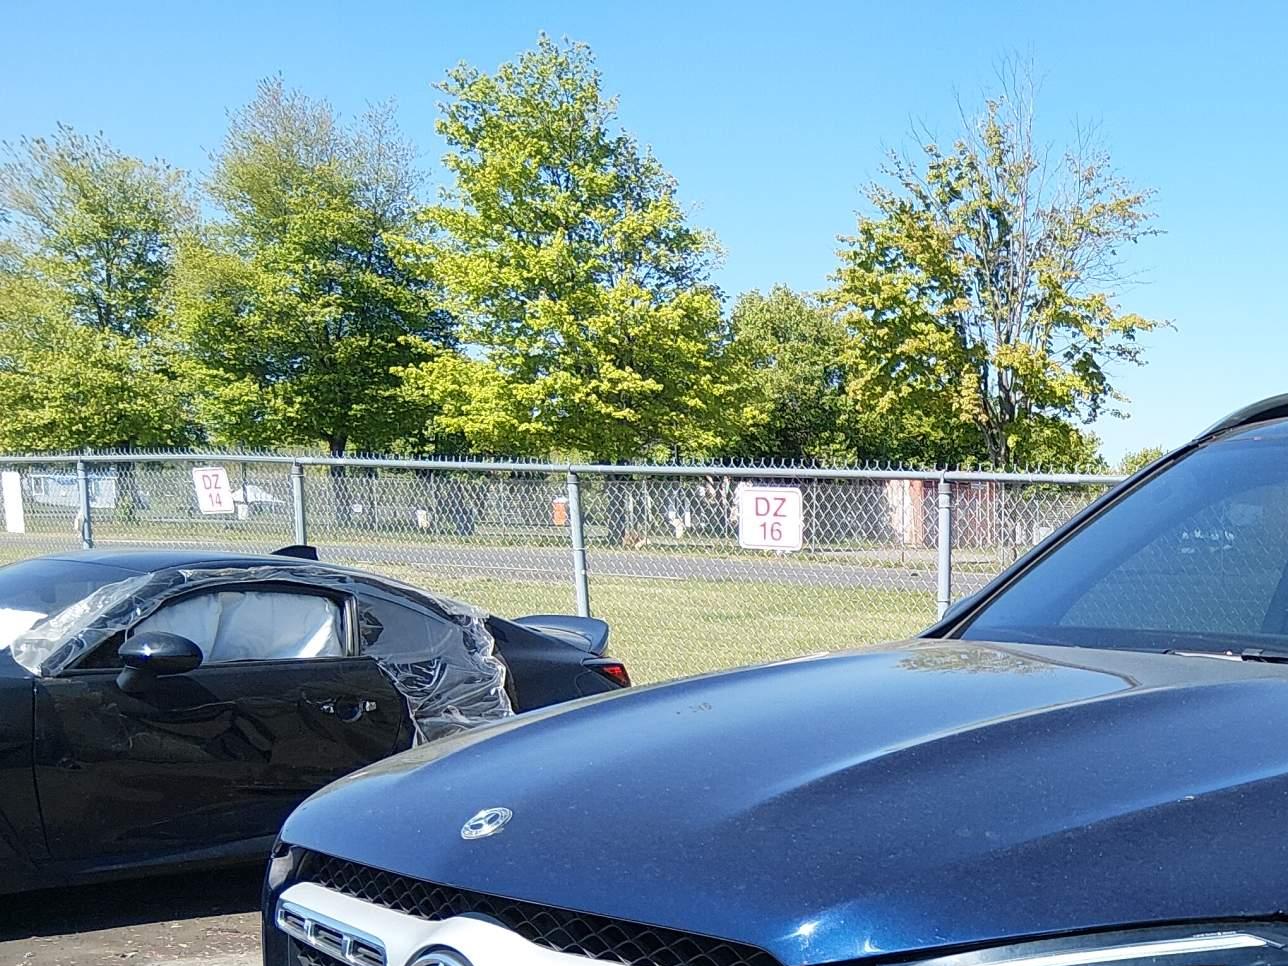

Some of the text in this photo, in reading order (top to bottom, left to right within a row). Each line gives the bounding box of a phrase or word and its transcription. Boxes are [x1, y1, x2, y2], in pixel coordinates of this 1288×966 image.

[202, 474, 222, 490] DZ
[208, 492, 222, 507] 14
[755, 497, 787, 517] DZ
[759, 521, 782, 541] 16
